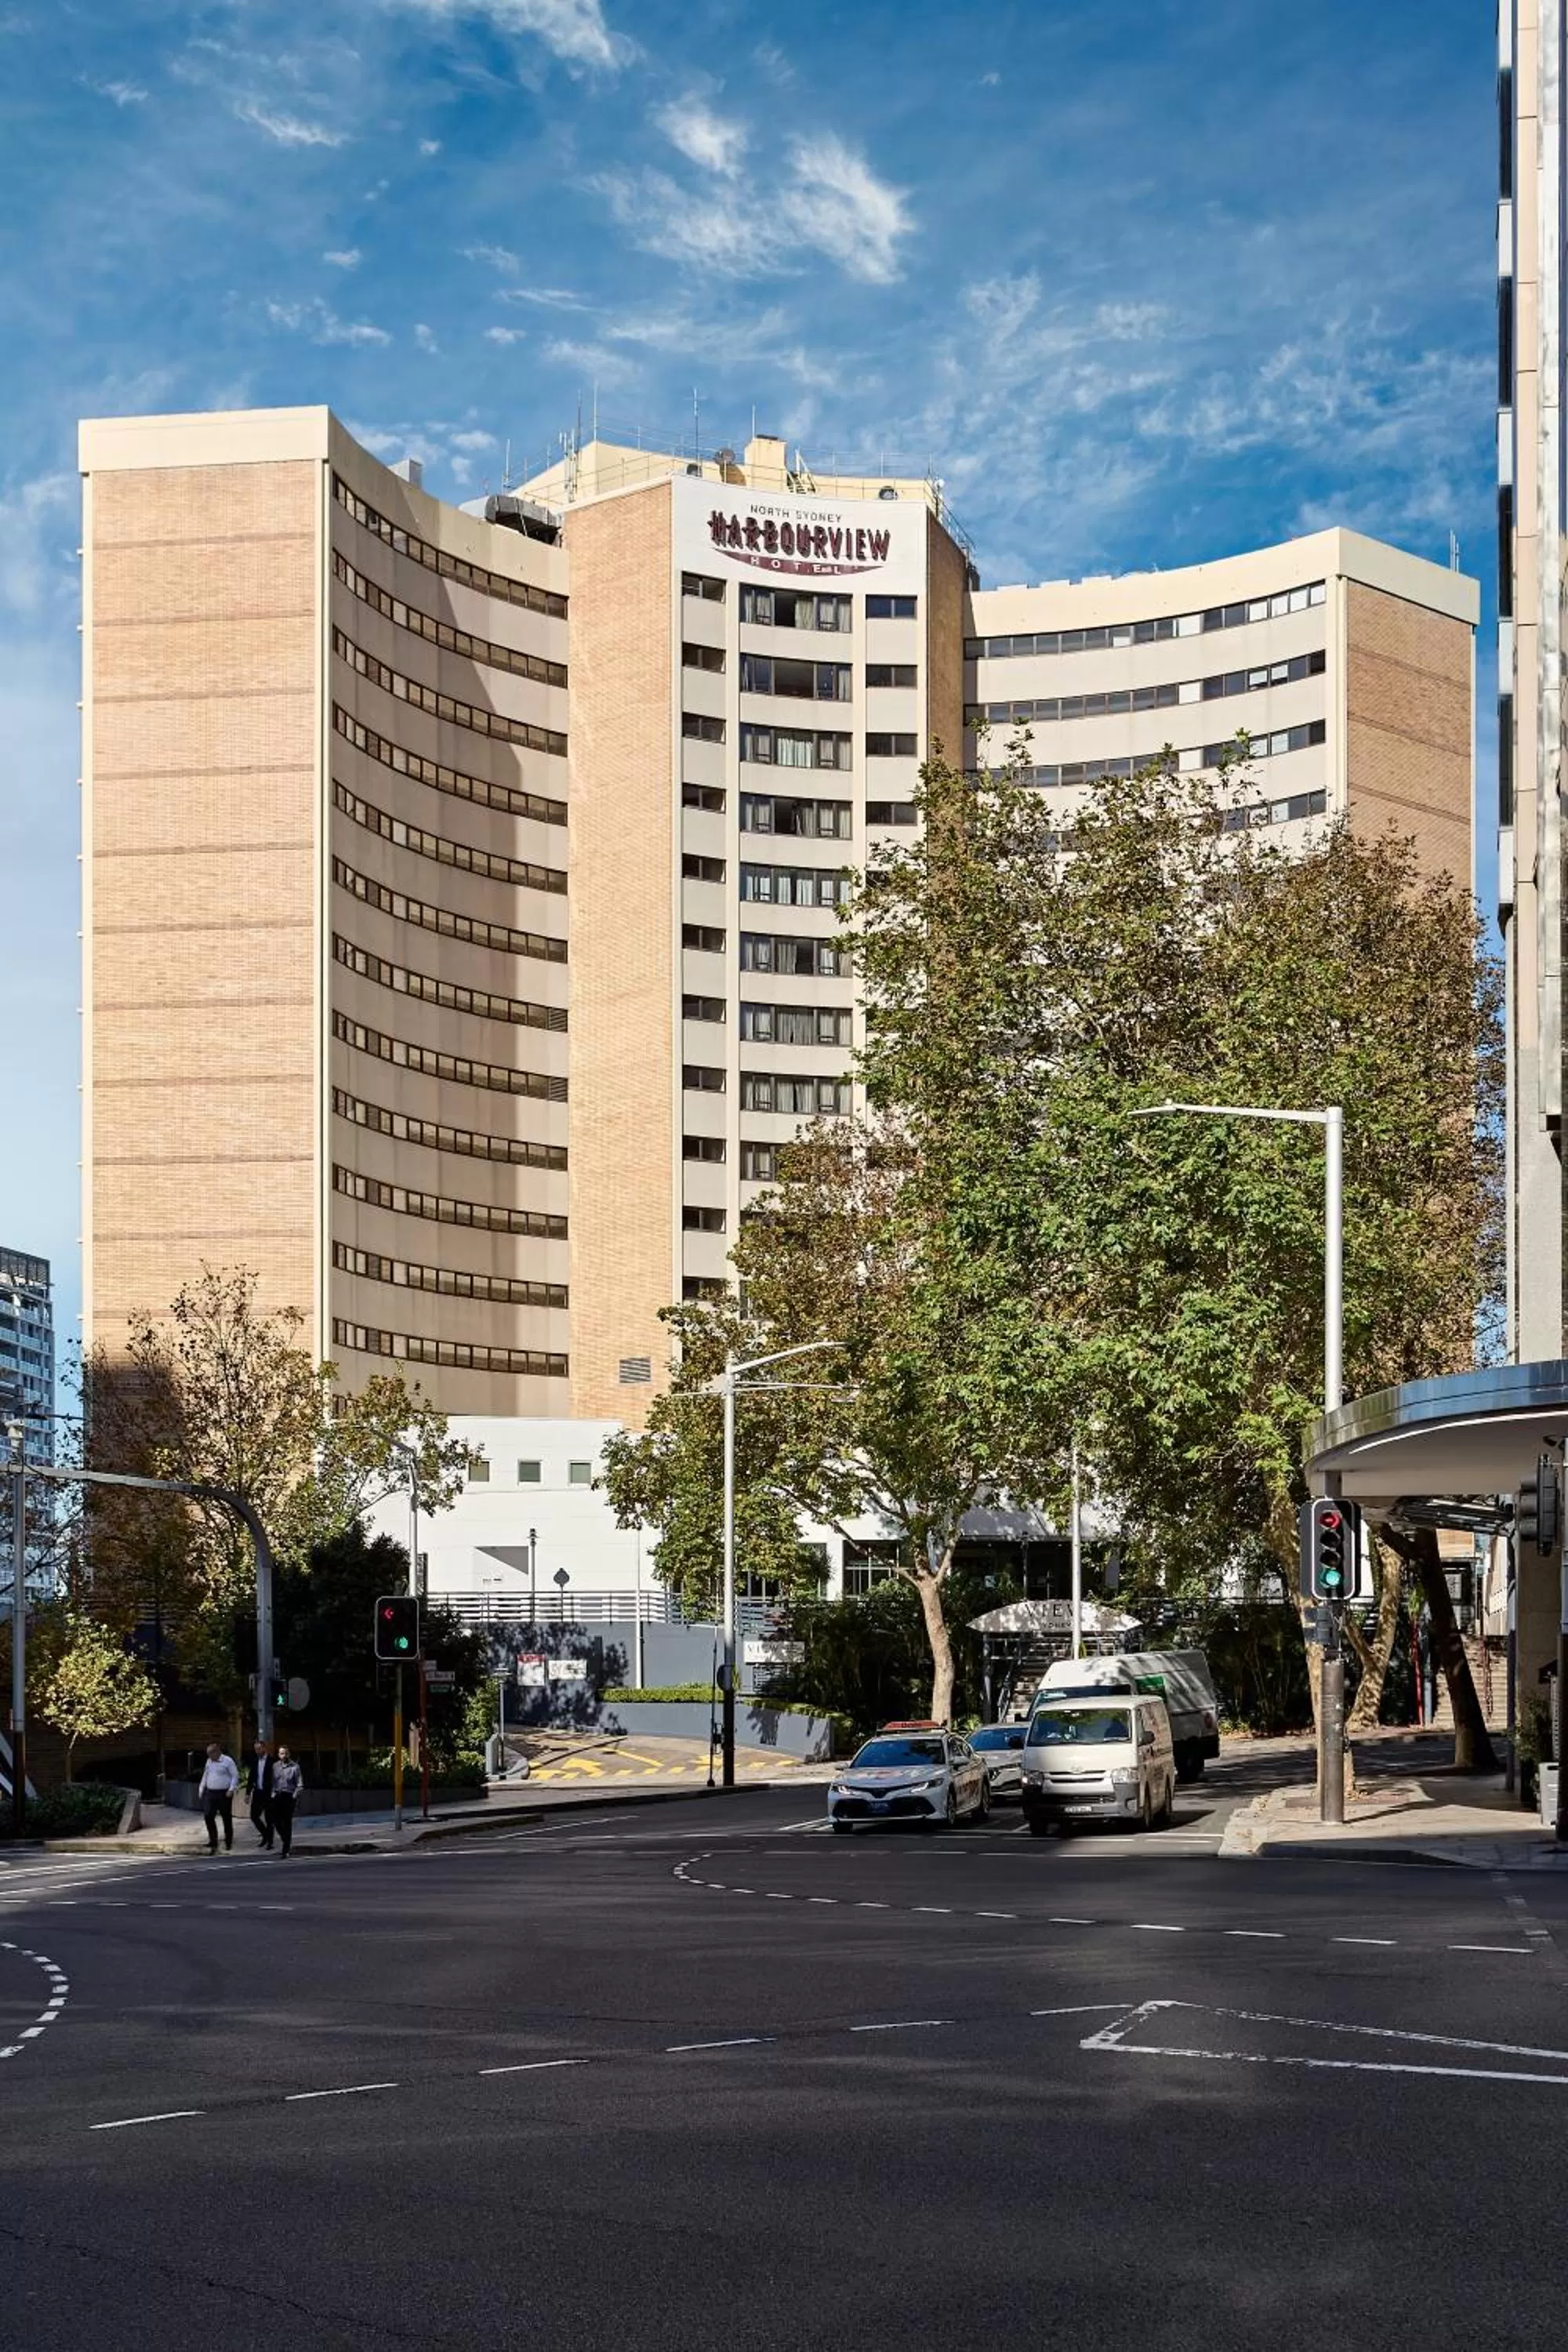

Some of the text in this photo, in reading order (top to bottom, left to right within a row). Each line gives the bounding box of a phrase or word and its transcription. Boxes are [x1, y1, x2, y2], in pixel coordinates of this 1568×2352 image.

[750, 504, 842, 523] NORTH SYDNEY
[707, 510, 891, 561] HARBOURVIEW
[750, 556, 841, 575] HOTEL
